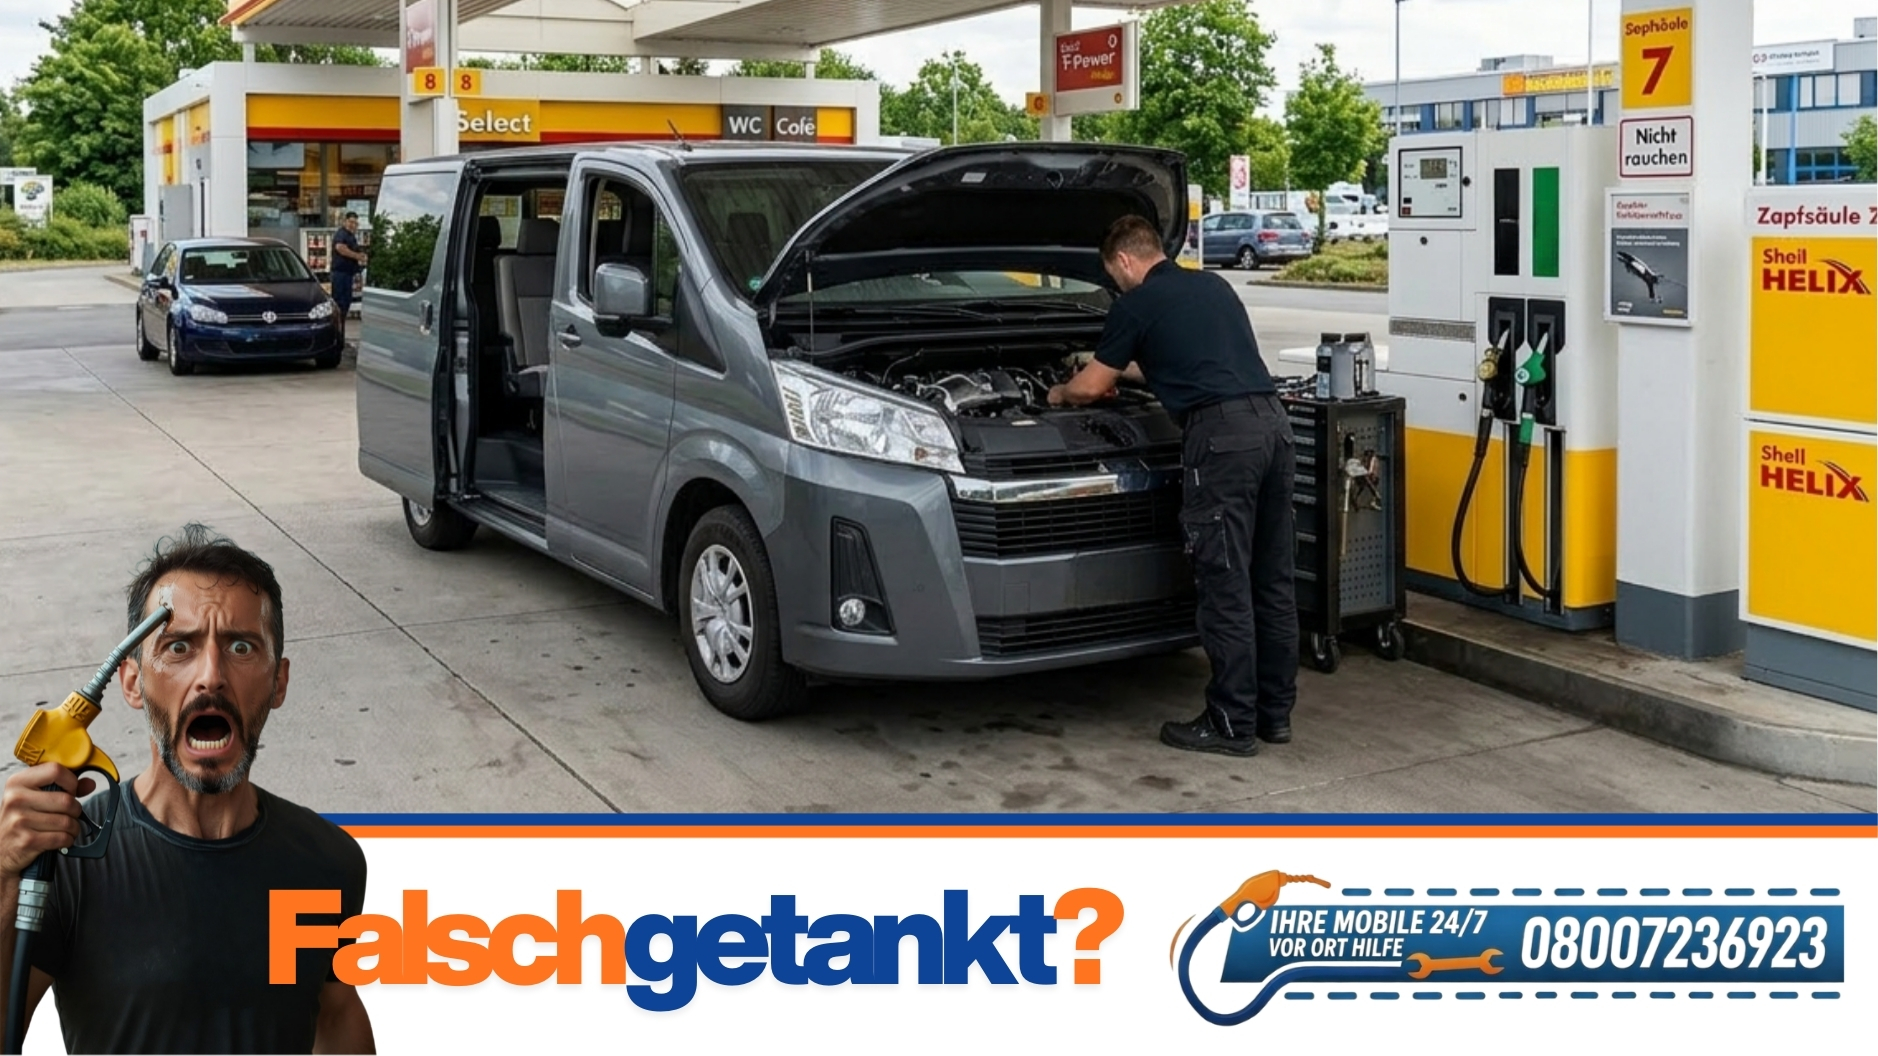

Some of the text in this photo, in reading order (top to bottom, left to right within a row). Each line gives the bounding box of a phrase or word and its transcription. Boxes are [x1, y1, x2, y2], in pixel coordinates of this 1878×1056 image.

[1642, 46, 1674, 95] 7
[425, 74, 436, 90] 8
[461, 74, 472, 91] 8
[457, 110, 531, 133] Select
[728, 116, 762, 134] WC
[1636, 126, 1677, 145] Nicht
[1625, 148, 1688, 166] rauchen
[1757, 205, 1861, 229] Zapfsäule
[1762, 260, 1871, 295] HELIX
[1761, 445, 1805, 466] Shell
[1761, 463, 1869, 503] HELIX
